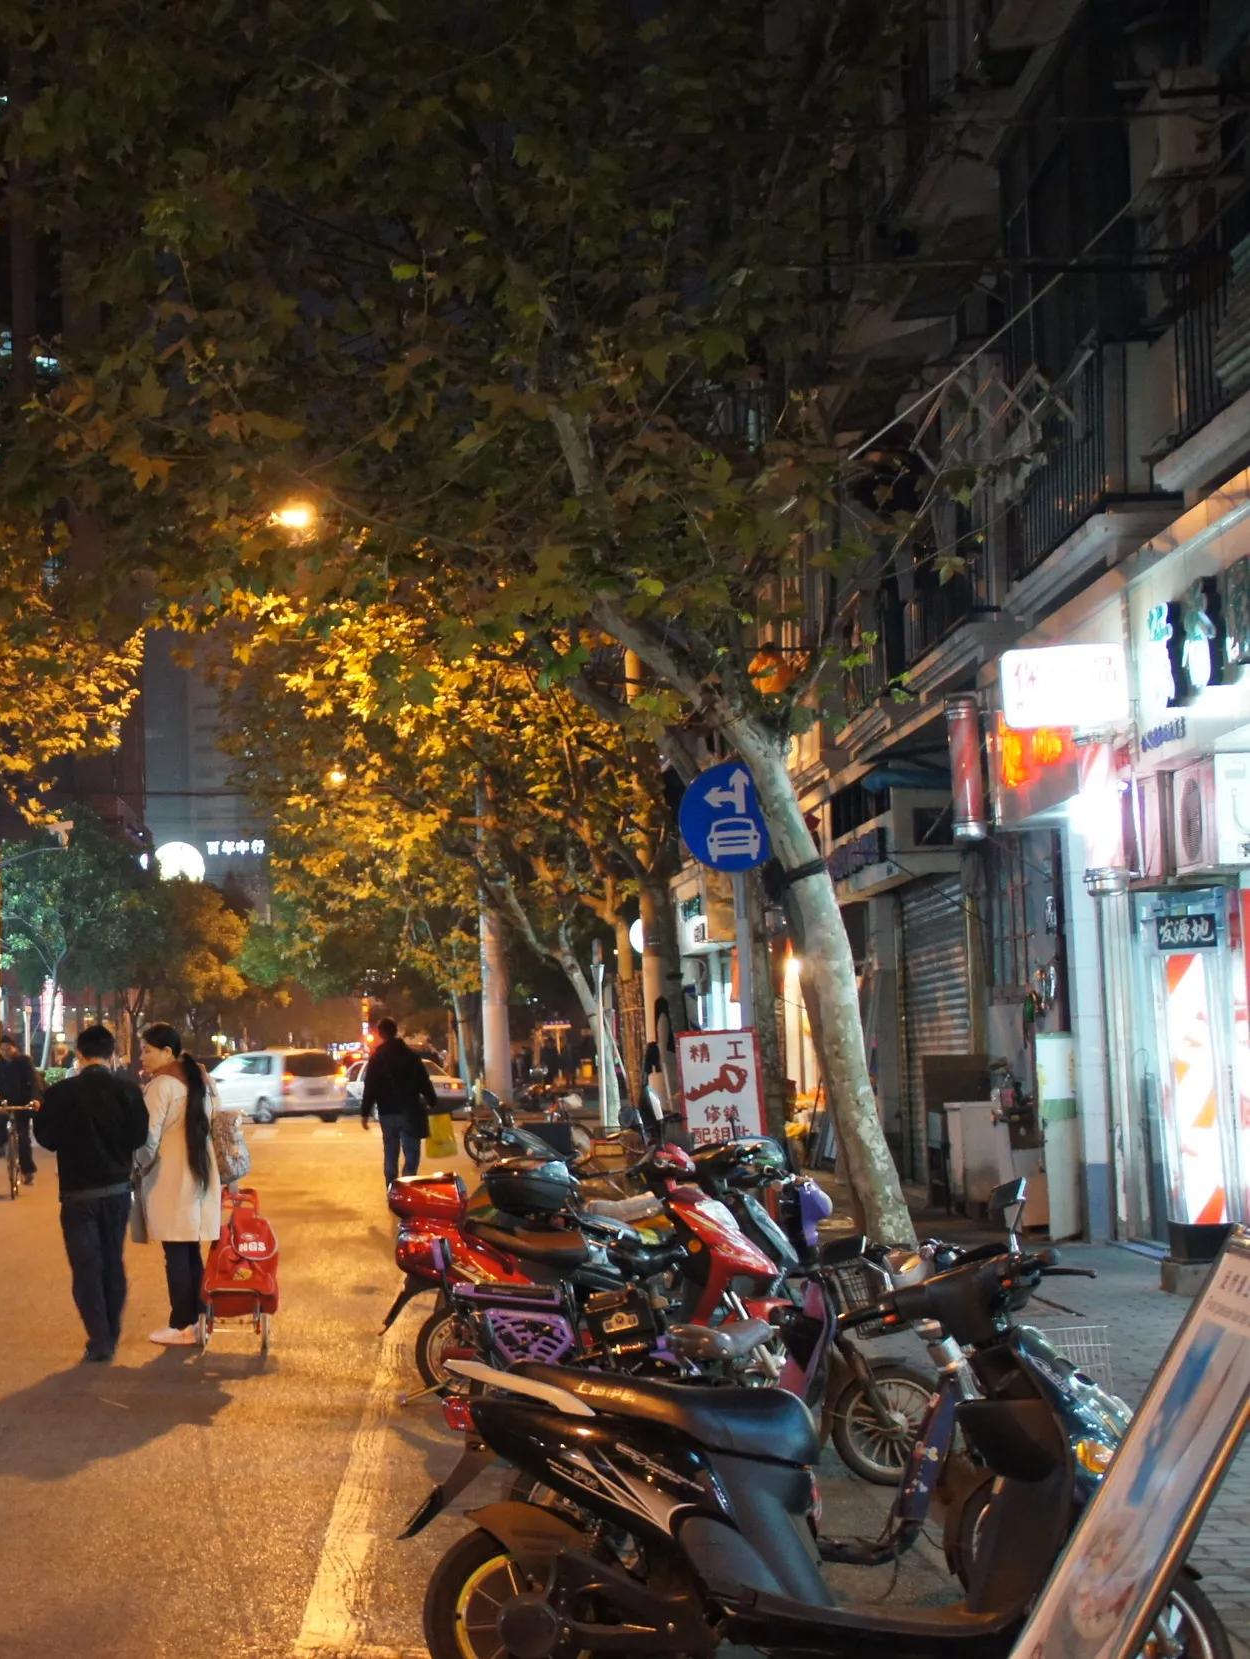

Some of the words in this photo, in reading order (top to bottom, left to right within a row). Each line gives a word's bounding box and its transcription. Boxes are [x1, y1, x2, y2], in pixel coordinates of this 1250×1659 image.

[206, 839, 266, 856] 百年中行
[688, 1040, 747, 1063] 精工
